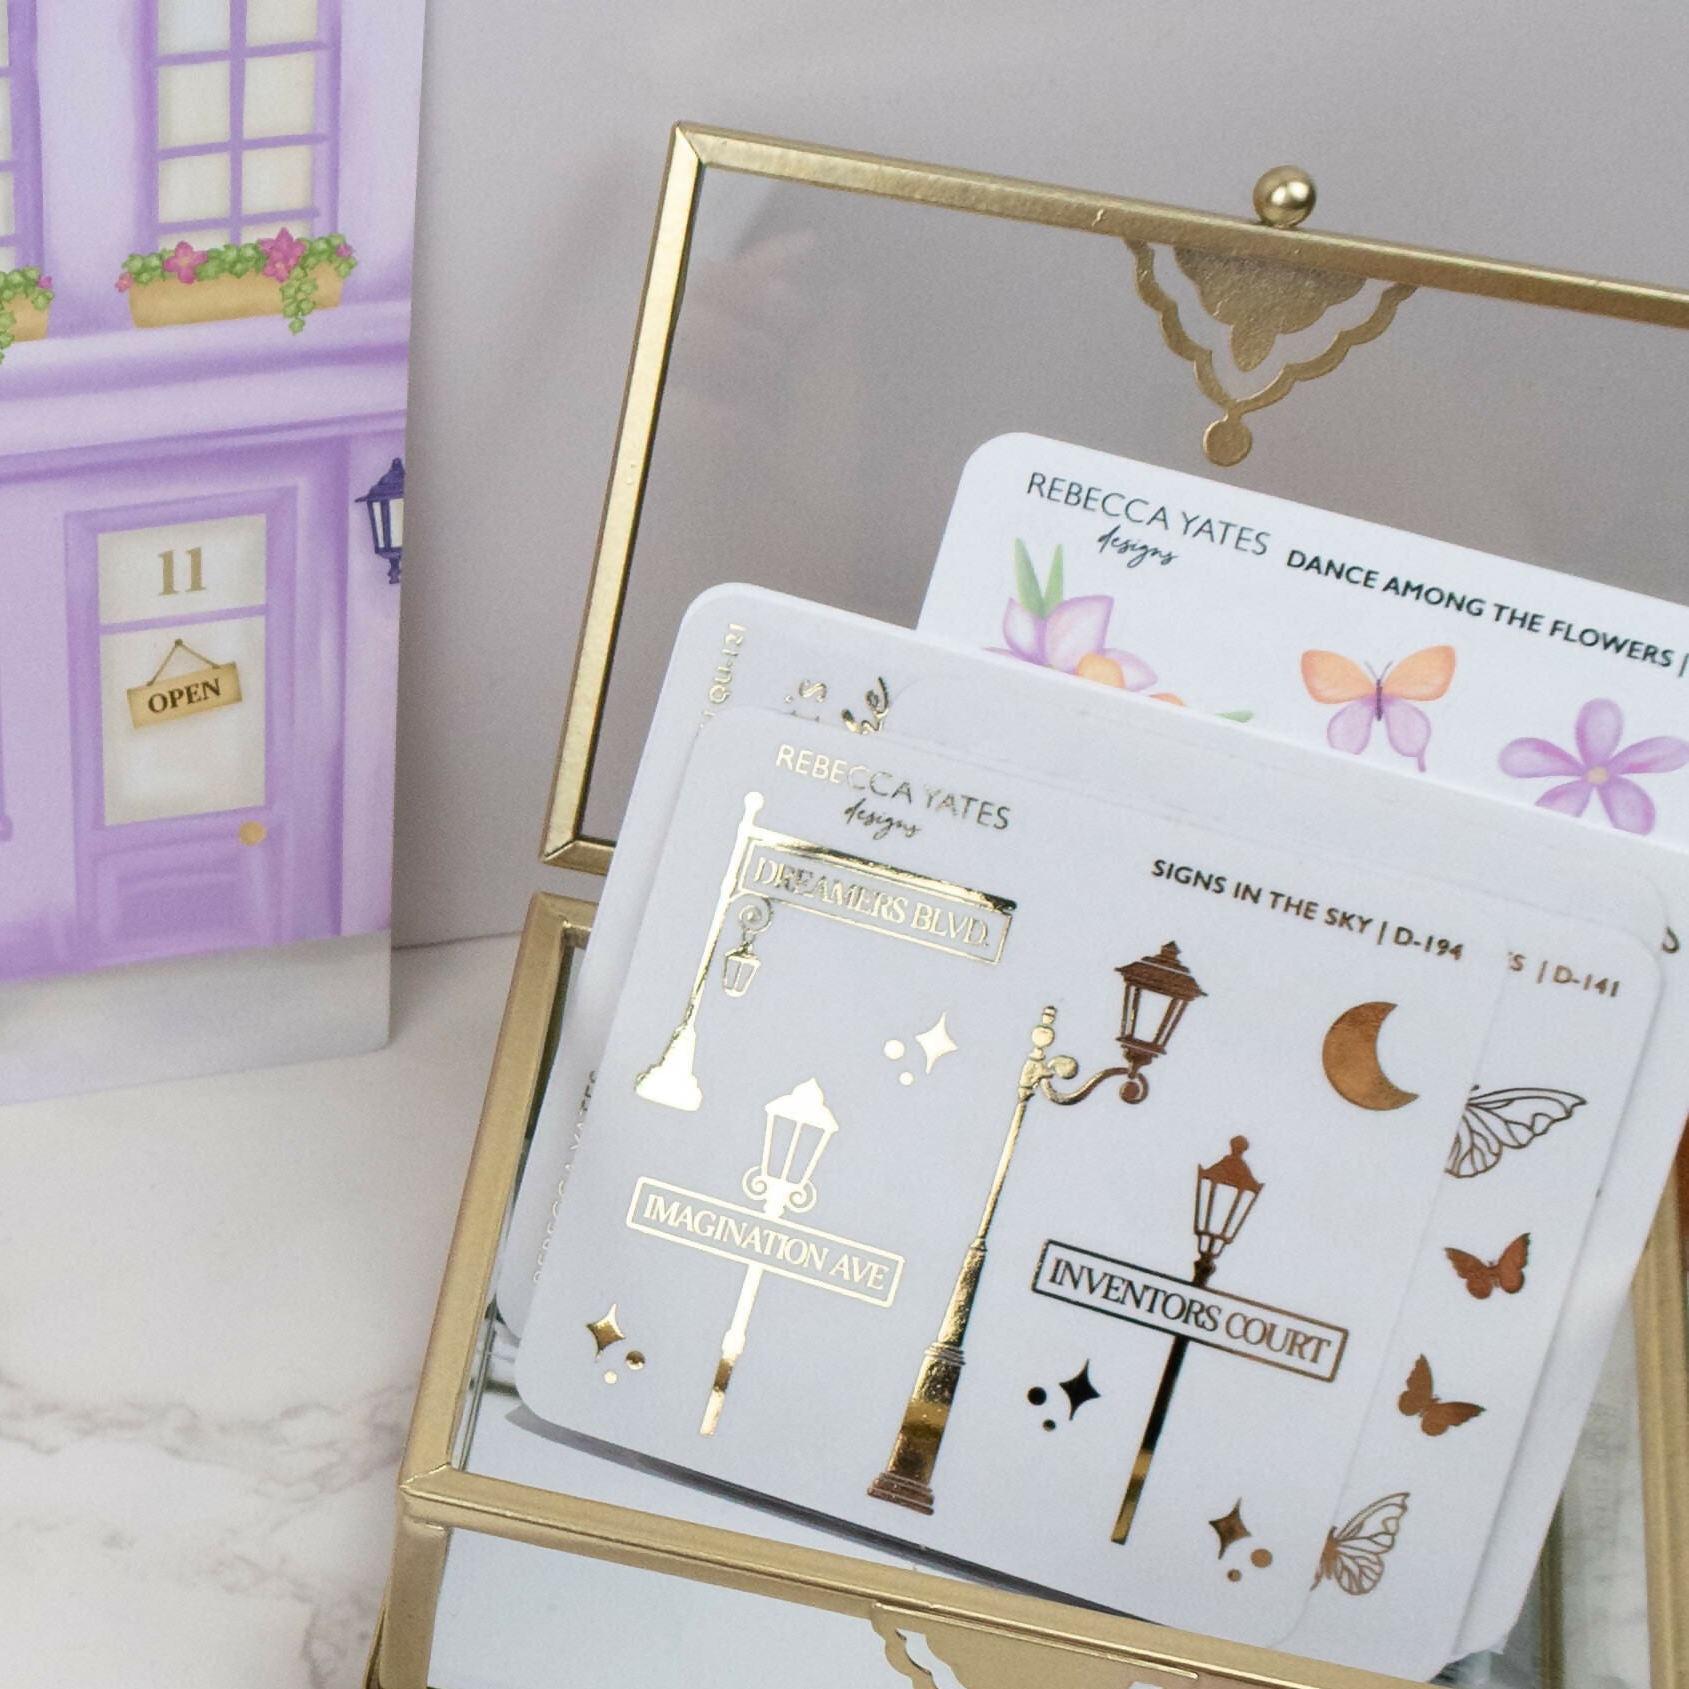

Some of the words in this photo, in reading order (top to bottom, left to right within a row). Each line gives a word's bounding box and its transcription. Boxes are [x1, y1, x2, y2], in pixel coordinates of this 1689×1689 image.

[1027, 472, 1170, 530] REBECCA
[1180, 511, 1271, 556] YATES
[1097, 524, 1180, 569] designs
[158, 546, 207, 596] 11
[1286, 549, 1379, 589] DANCE
[1382, 576, 1485, 617] AMONG
[1492, 603, 1544, 633] THE
[1548, 620, 1674, 668] FLOWERS
[148, 678, 222, 713] OPEN
[775, 744, 913, 804] REBECCA
[924, 783, 1011, 830] YATES
[843, 797, 922, 840] designs
[753, 856, 910, 925] DREAMERS
[1151, 859, 1228, 894] SIGNS
[1232, 881, 1262, 904] IN
[1268, 891, 1319, 920] THE
[1324, 907, 1374, 934] SKY
[1392, 926, 1464, 961] D-194
[1552, 964, 1620, 998] D-141
[643, 1193, 830, 1272] IMAGINATION
[829, 1253, 890, 1291] AVE
[1049, 1258, 1223, 1333] INVENTORS
[1225, 1312, 1331, 1365] COURT
